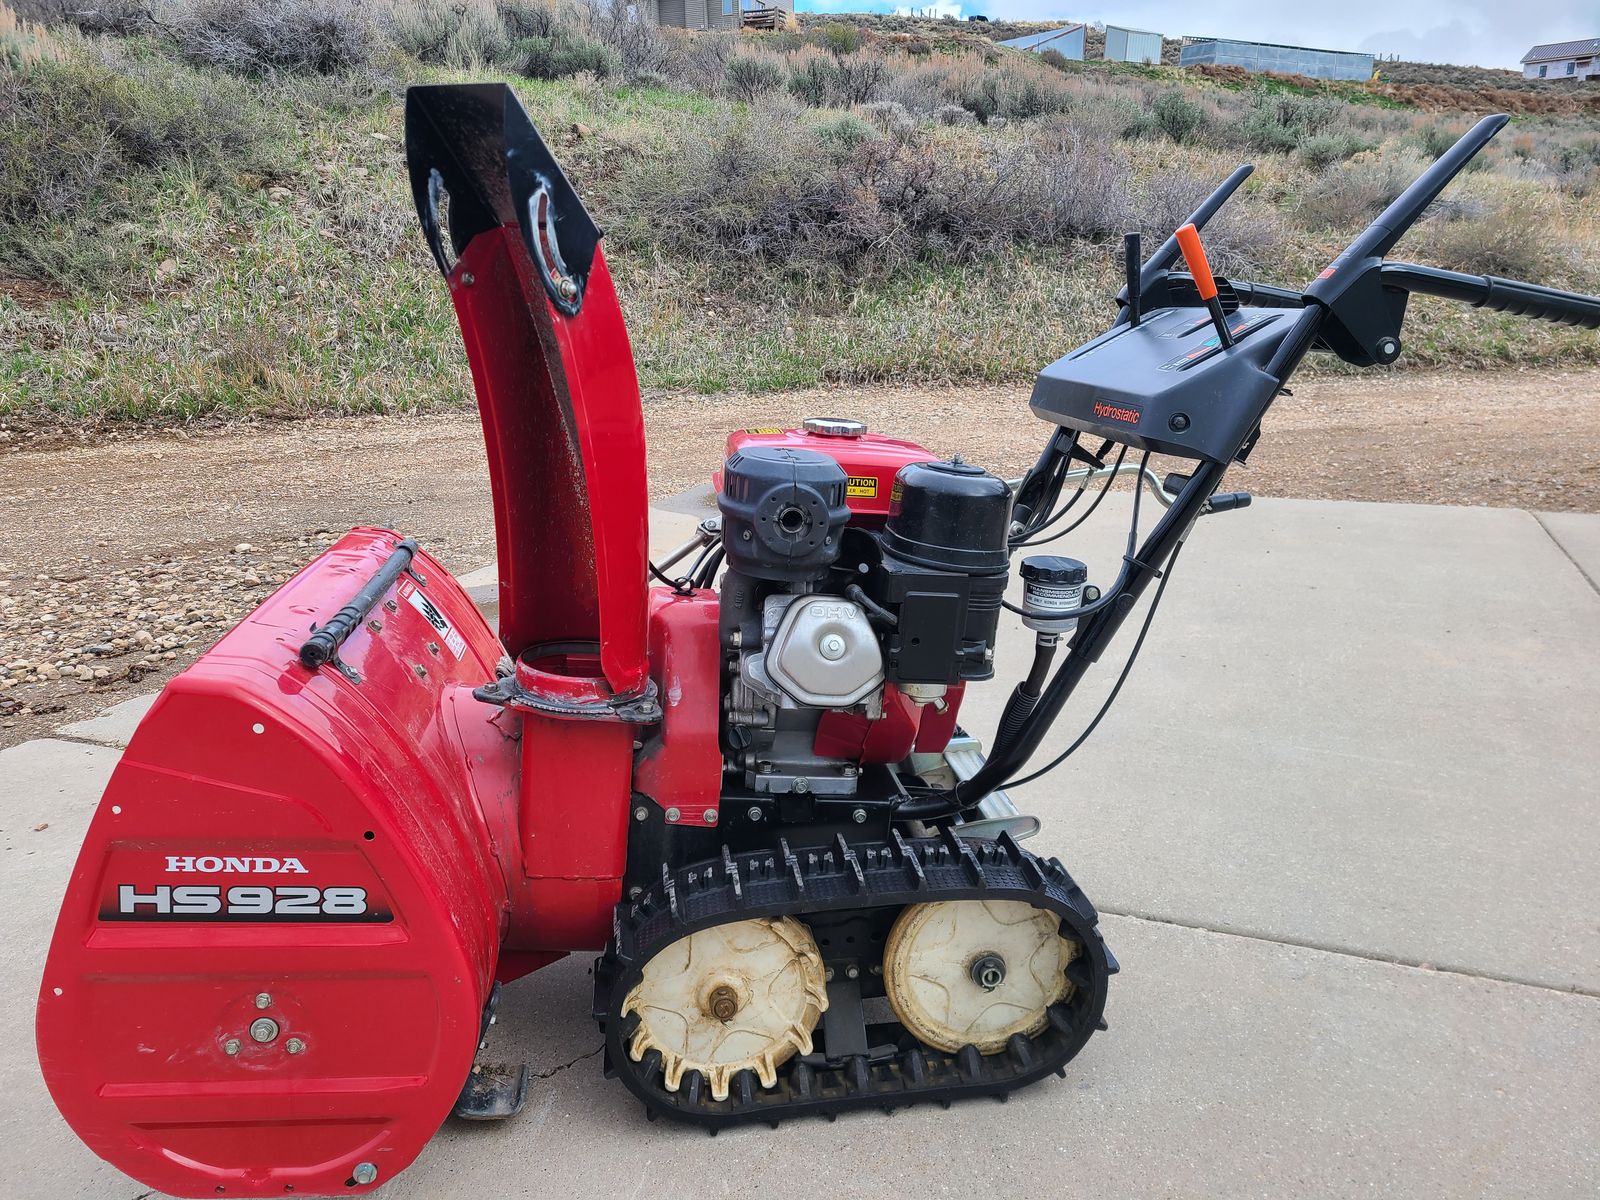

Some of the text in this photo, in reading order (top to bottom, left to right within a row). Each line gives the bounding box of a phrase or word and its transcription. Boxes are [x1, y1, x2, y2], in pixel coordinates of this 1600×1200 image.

[1093, 401, 1140, 424] Hydrostatic
[810, 606, 858, 619] OHV
[165, 856, 309, 873] HONDA
[118, 884, 368, 915] HS928
